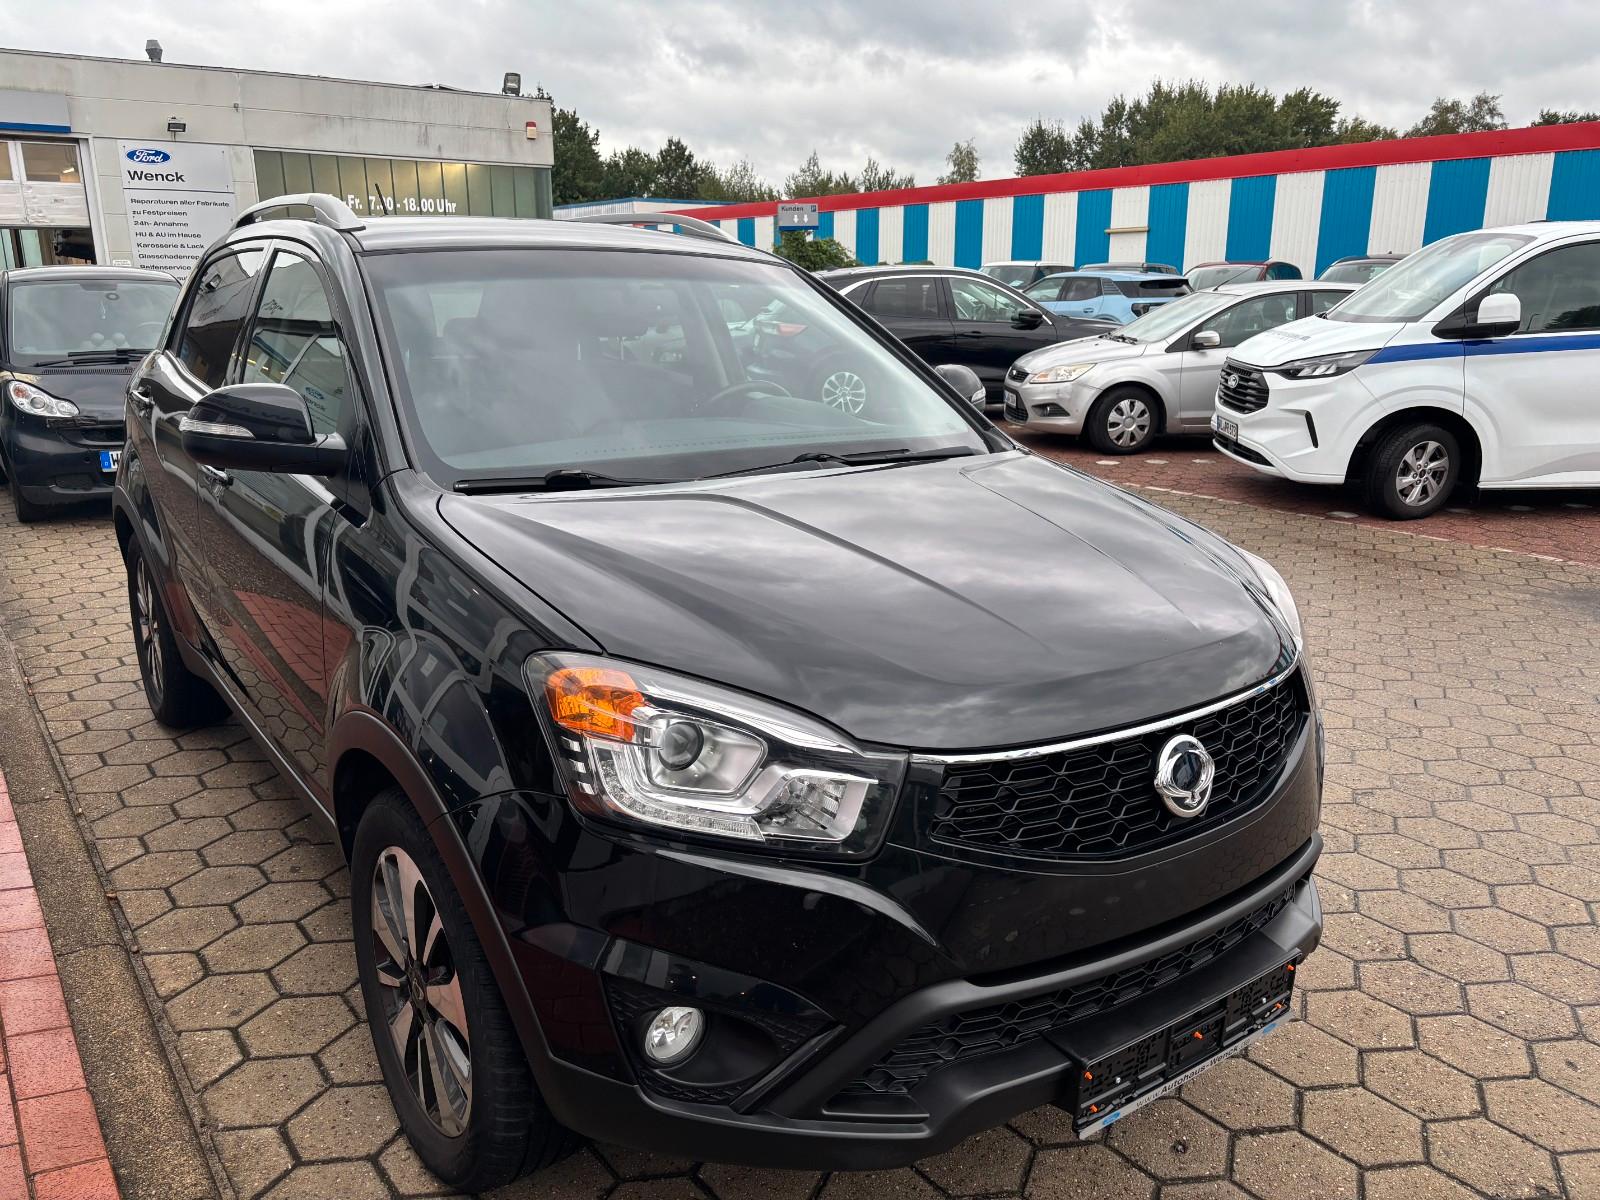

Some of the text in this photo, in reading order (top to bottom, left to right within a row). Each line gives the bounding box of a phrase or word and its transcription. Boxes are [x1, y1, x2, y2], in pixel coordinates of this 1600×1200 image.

[132, 149, 165, 163] Ford
[127, 170, 185, 182] Wenck
[403, 197, 434, 212] 18.00
[437, 198, 457, 213] Uhr
